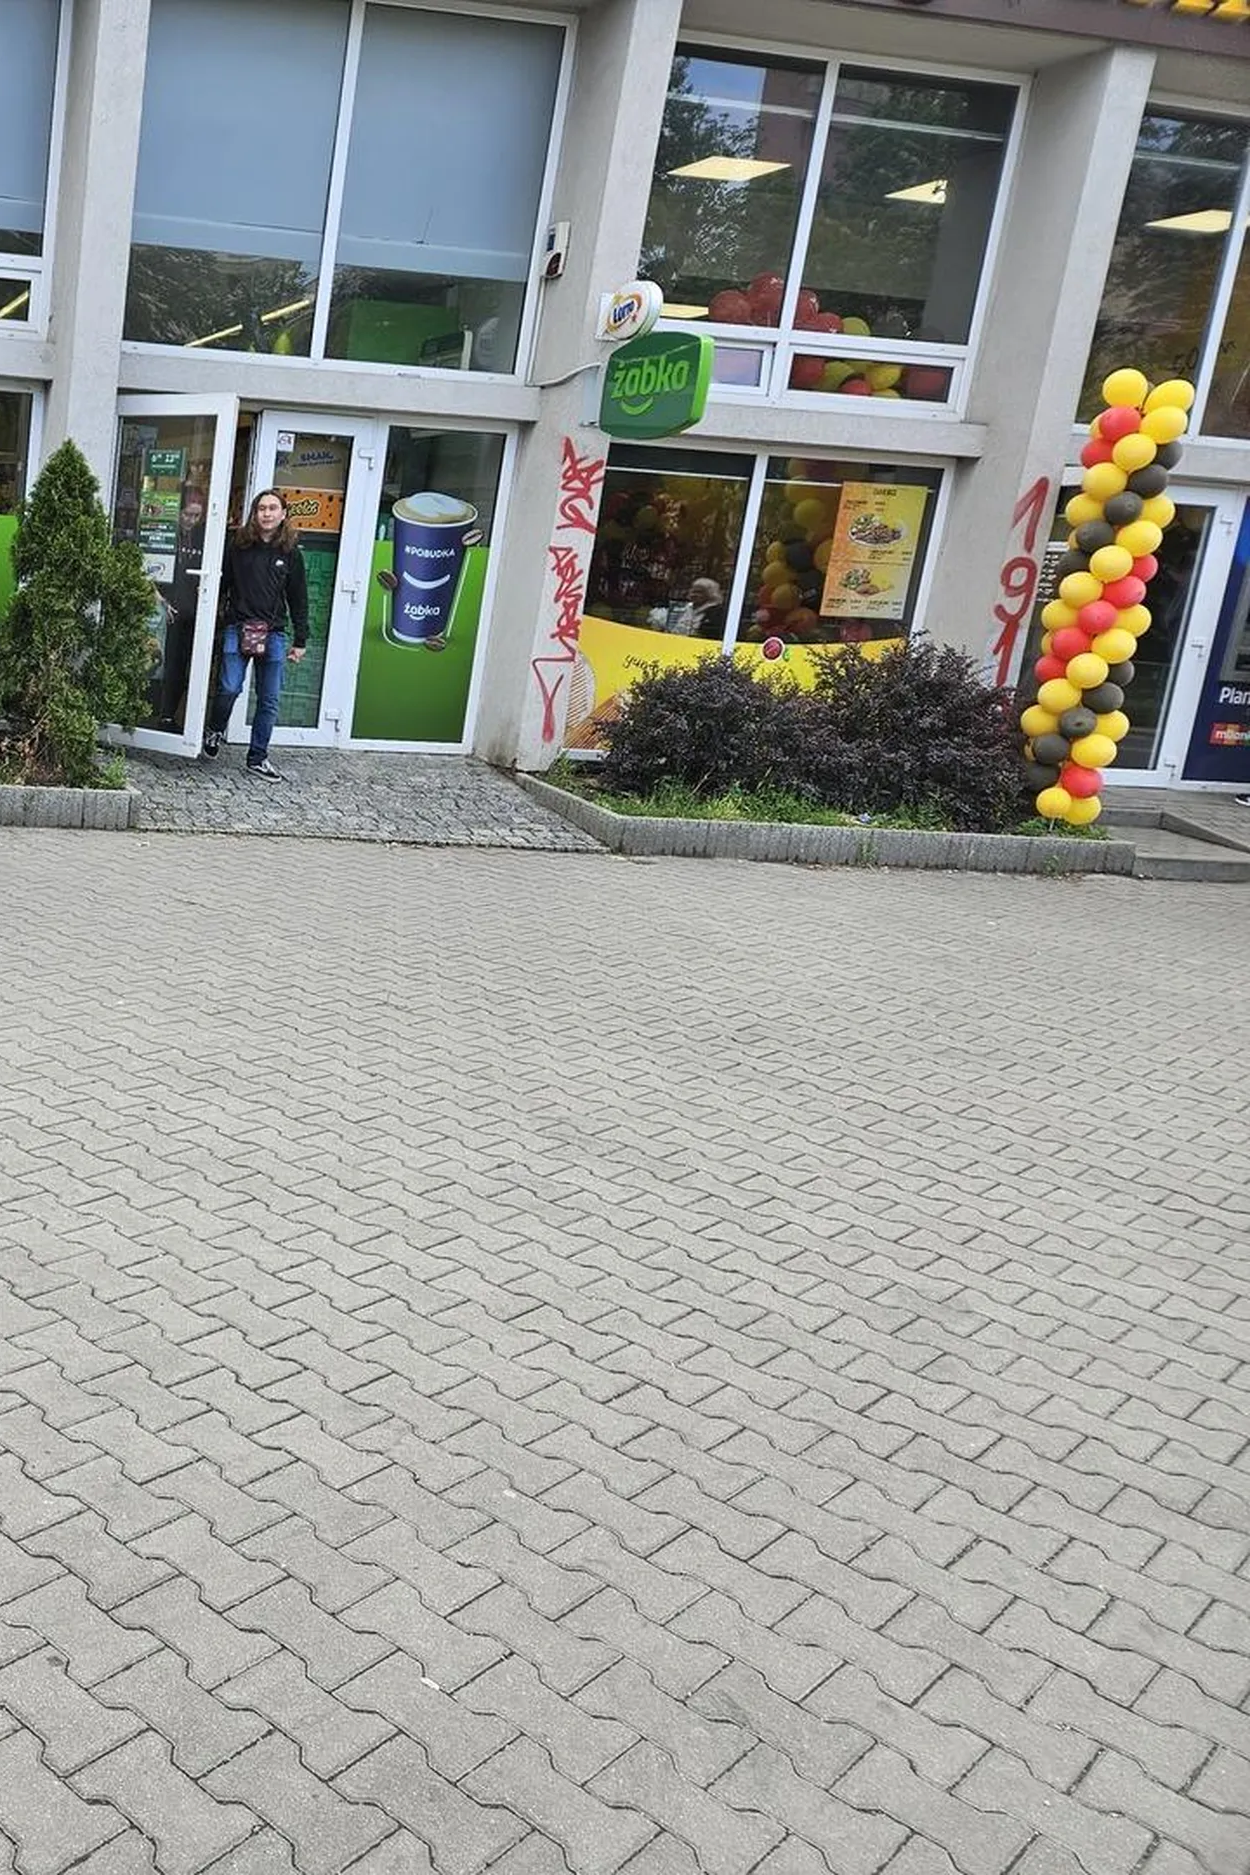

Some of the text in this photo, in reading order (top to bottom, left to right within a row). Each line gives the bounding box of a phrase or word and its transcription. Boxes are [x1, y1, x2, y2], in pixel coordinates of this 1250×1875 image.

[611, 355, 690, 399] żabka
[404, 545, 456, 558] #POBUDKA
[403, 602, 441, 616] żabka
